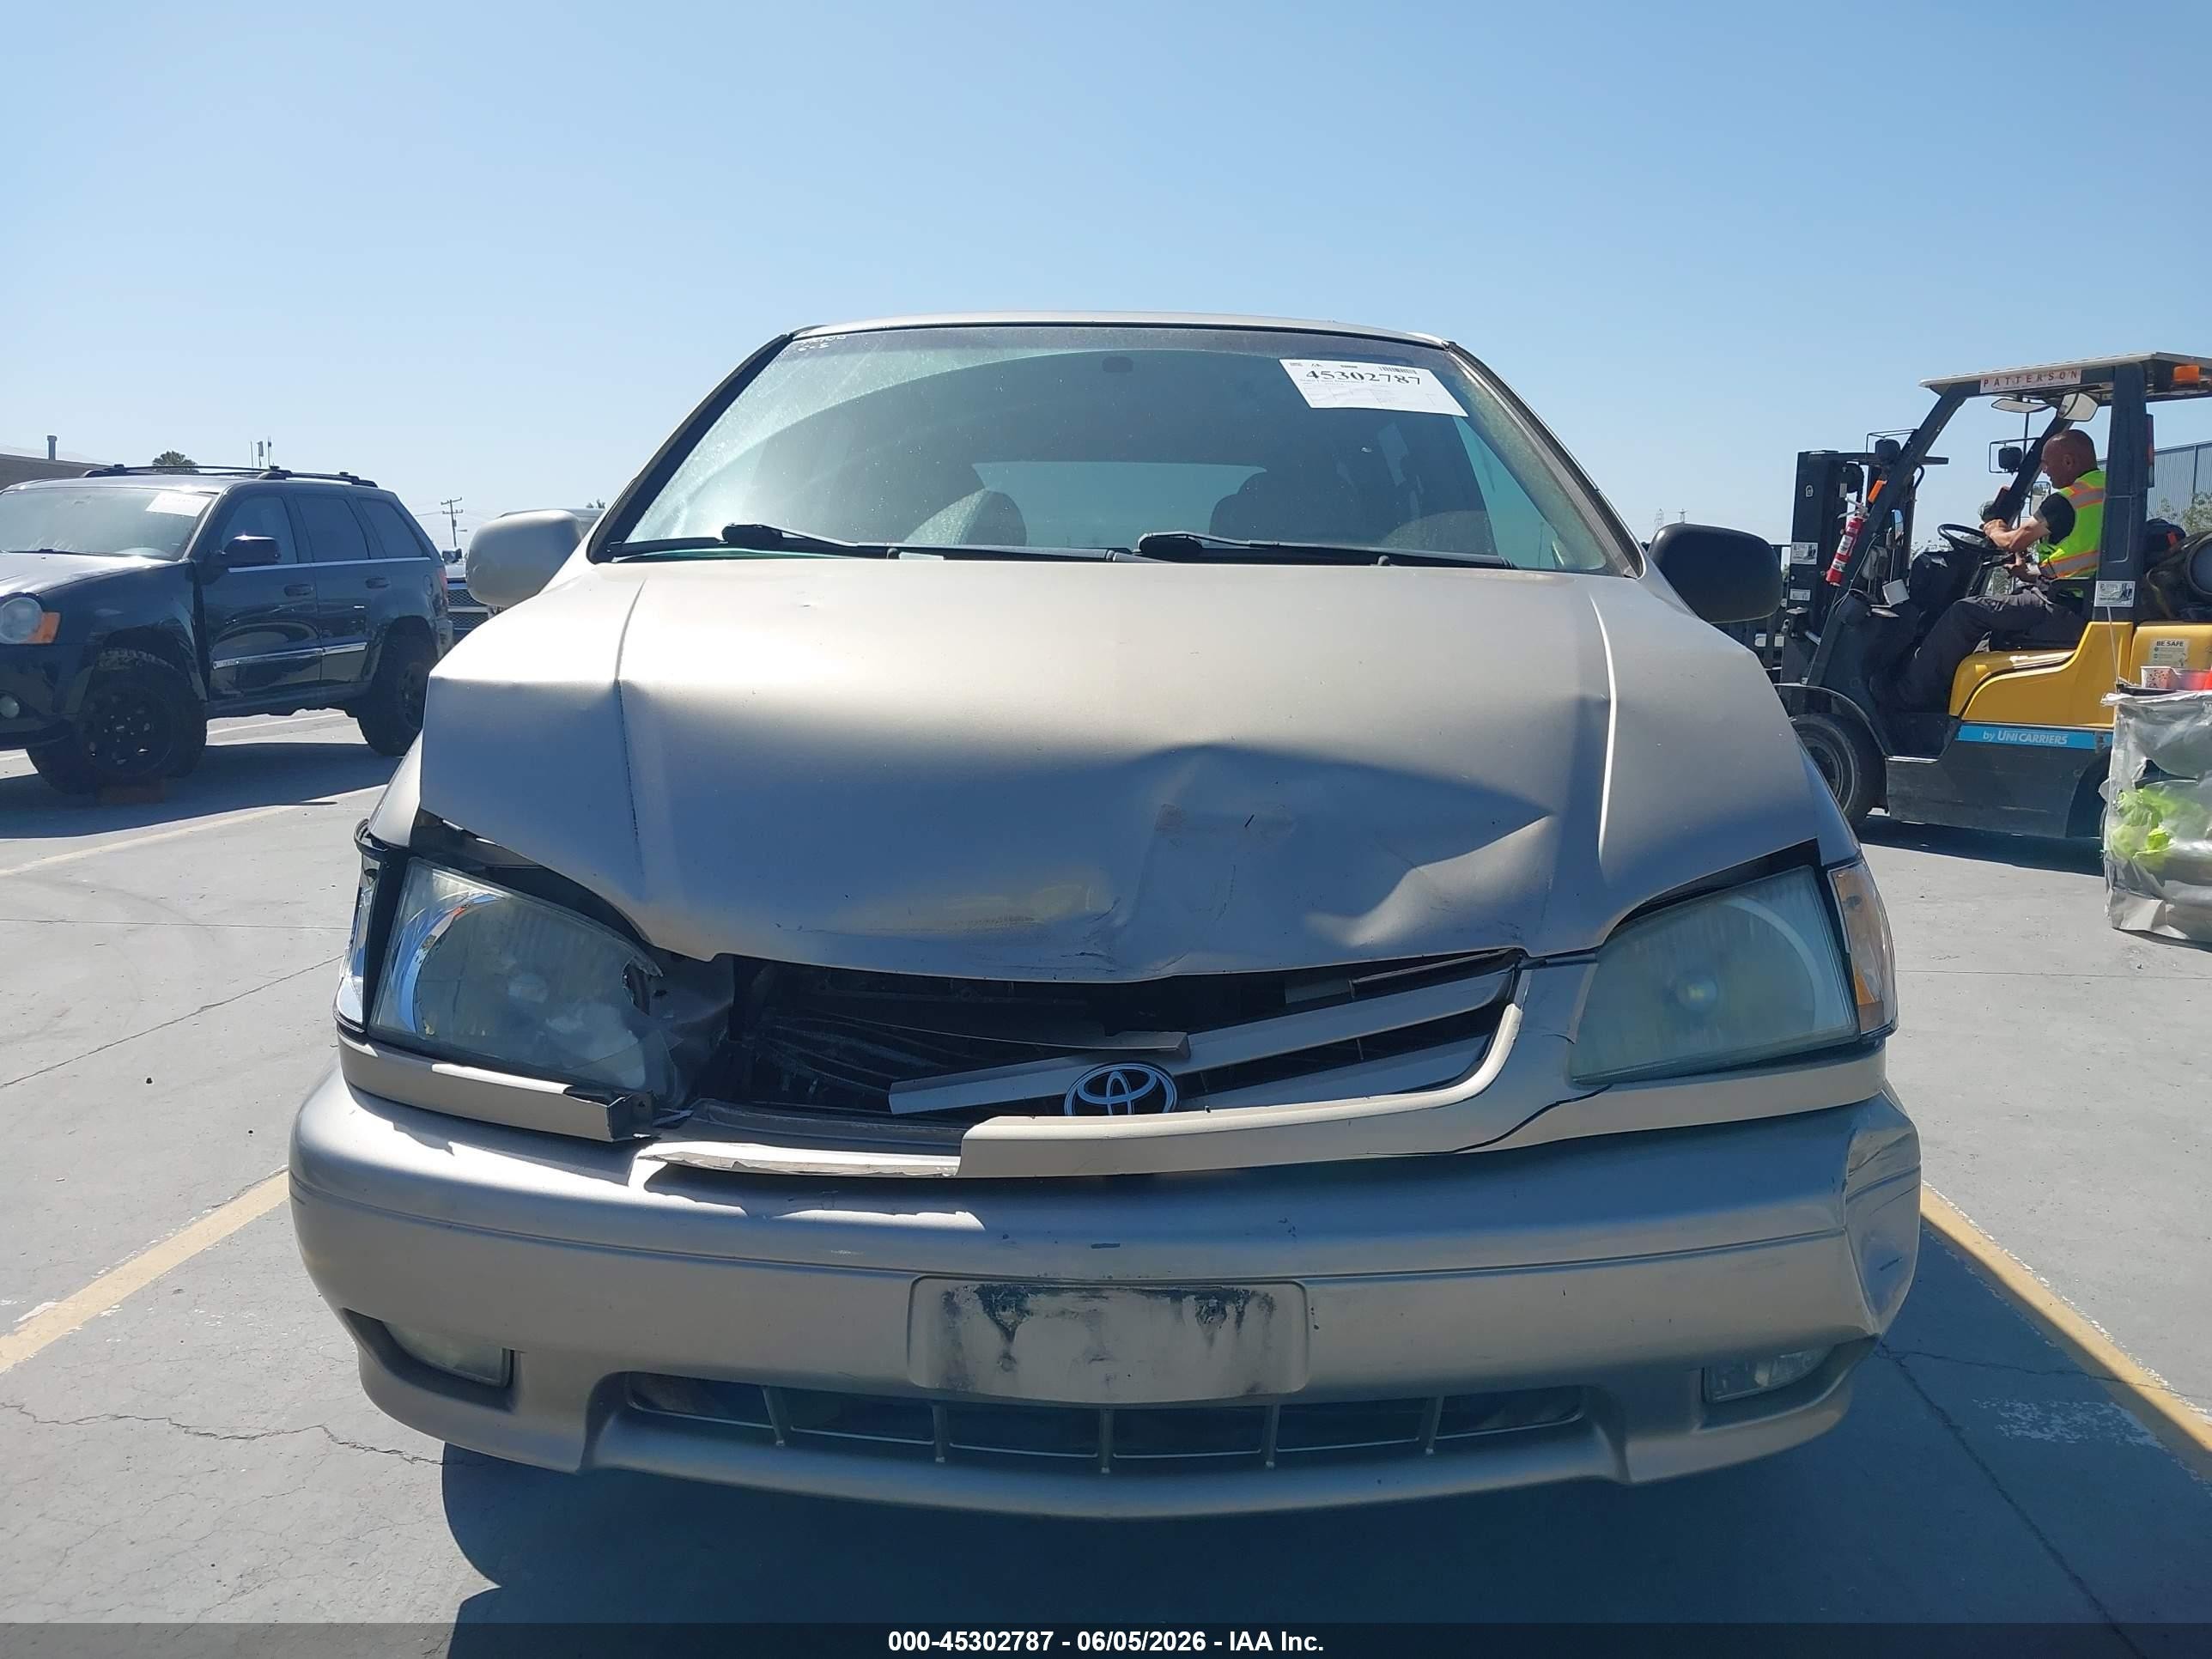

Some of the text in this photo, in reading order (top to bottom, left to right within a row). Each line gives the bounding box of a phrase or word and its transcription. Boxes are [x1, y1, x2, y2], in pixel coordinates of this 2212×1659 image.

[1305, 370, 1420, 386] 45302787
[1983, 370, 2078, 387] PATTERSON
[1982, 730, 1995, 742] by
